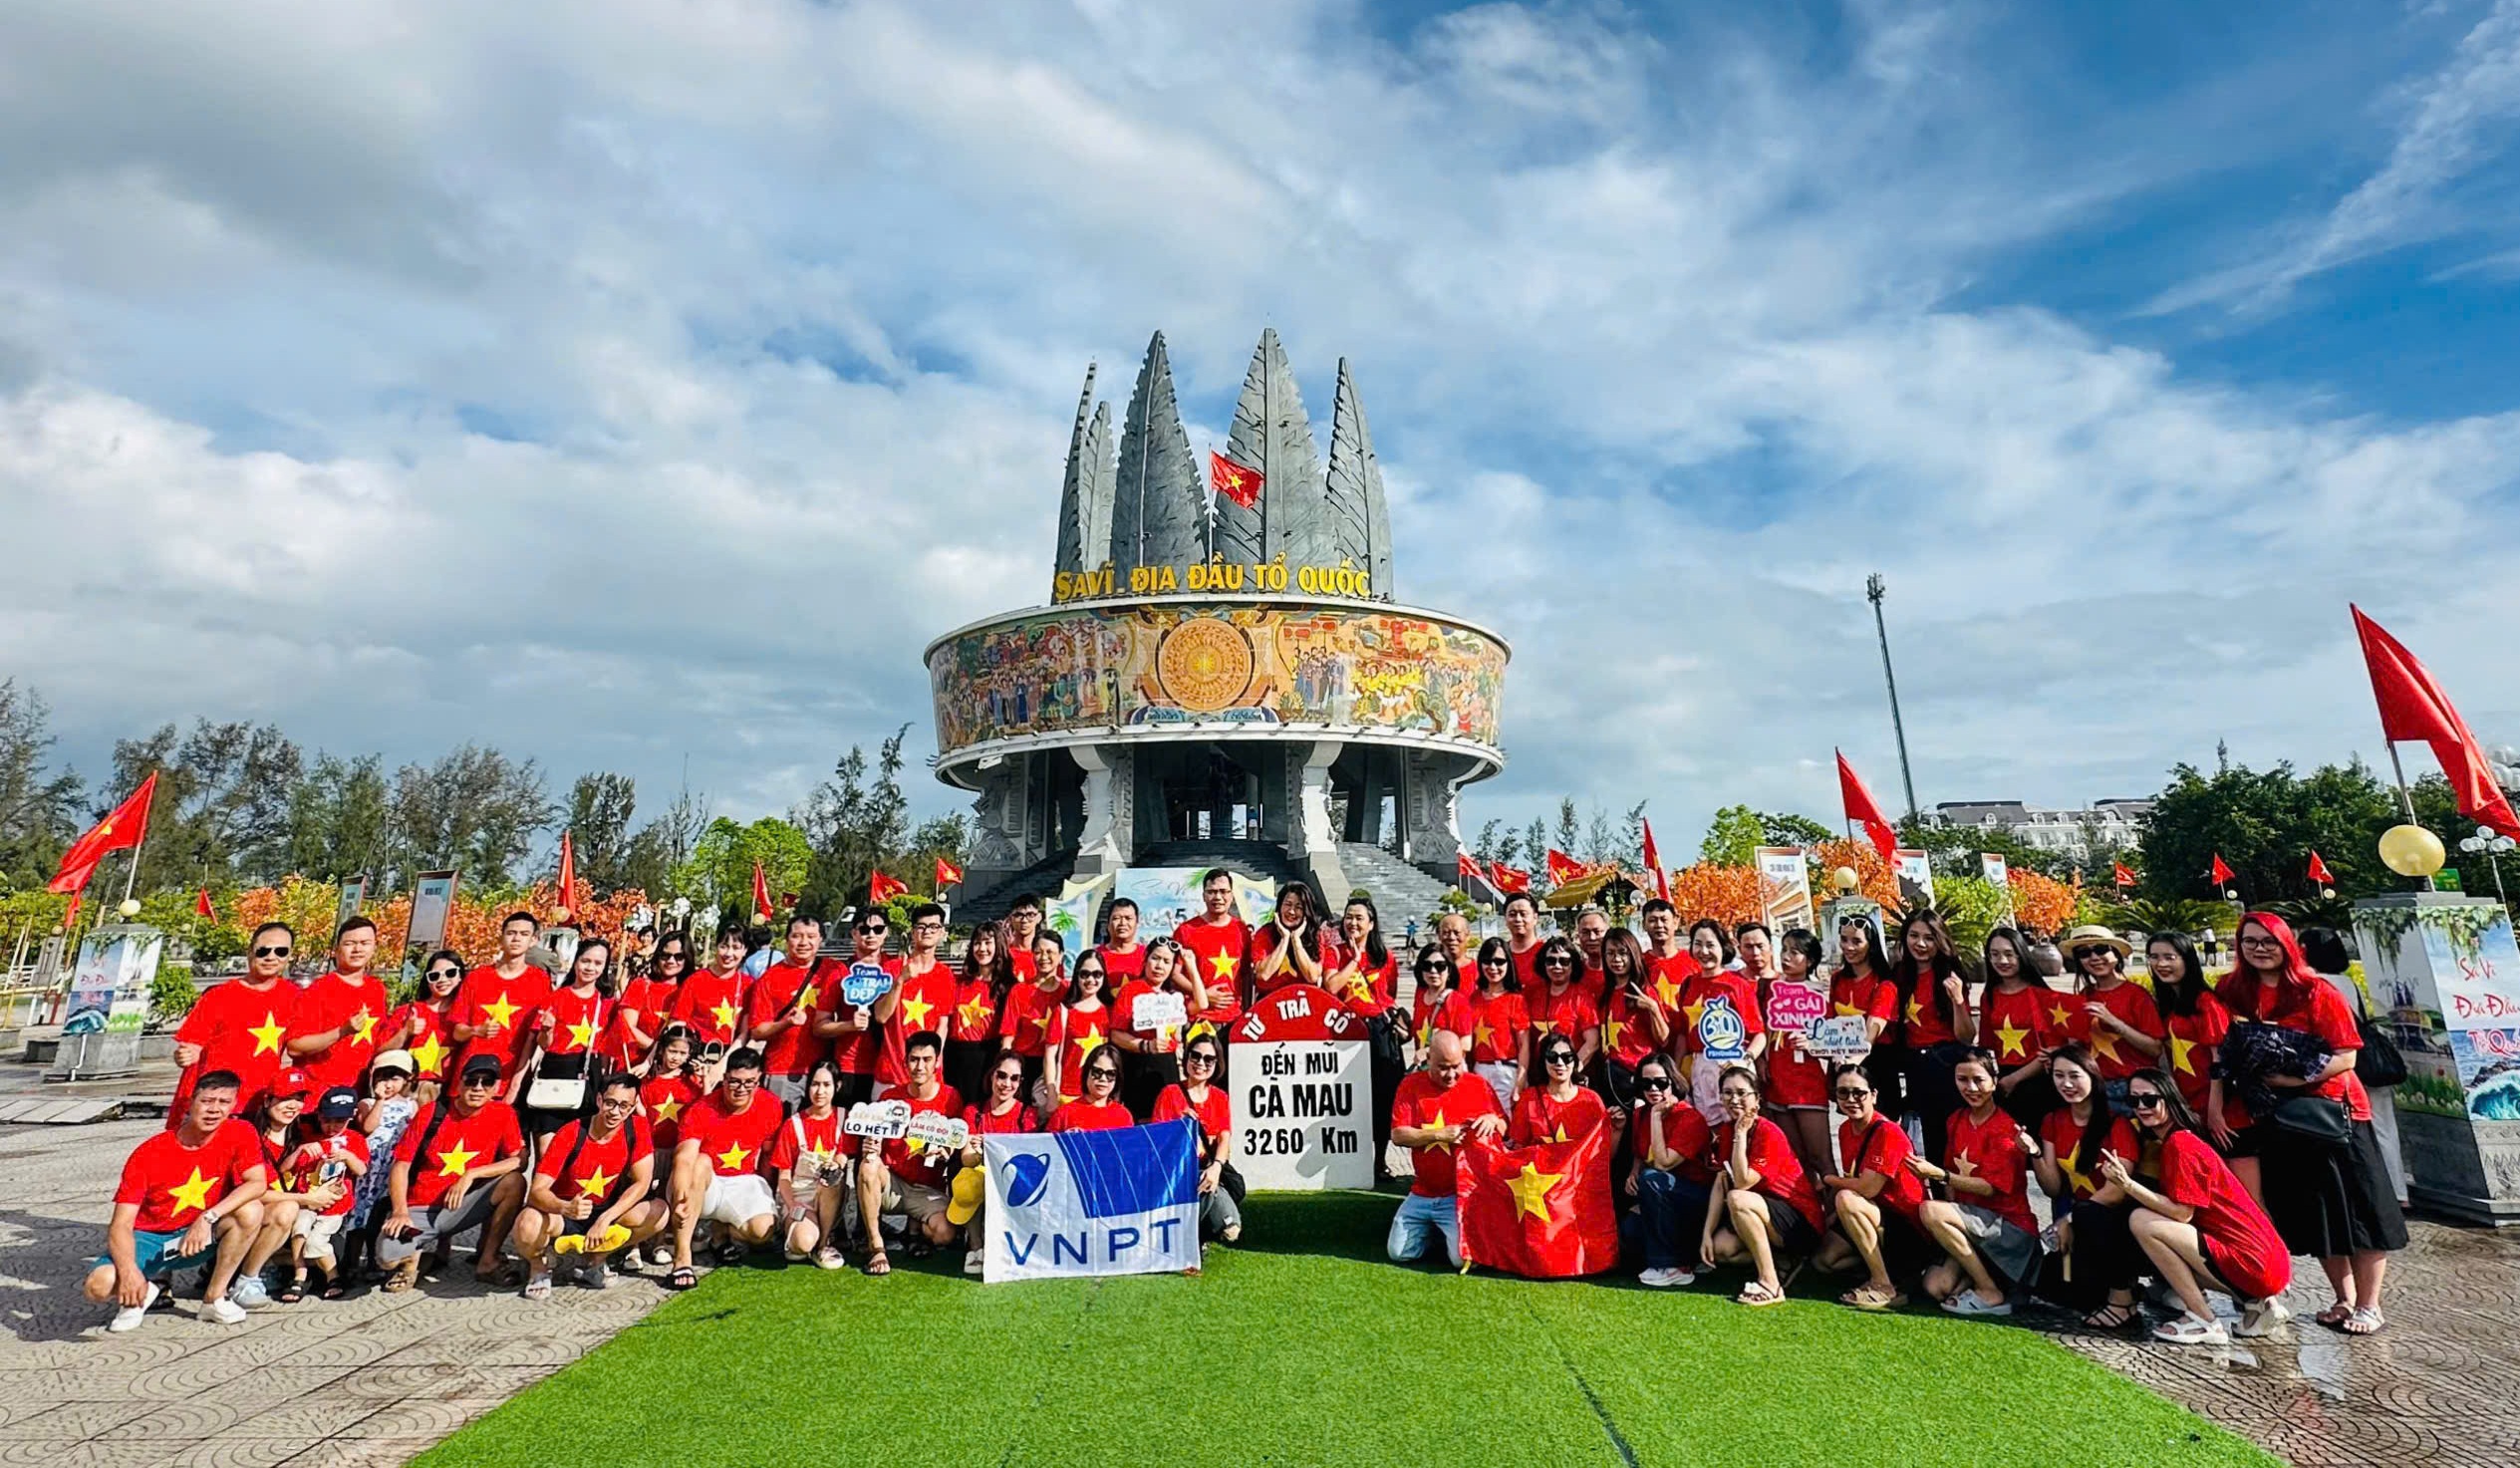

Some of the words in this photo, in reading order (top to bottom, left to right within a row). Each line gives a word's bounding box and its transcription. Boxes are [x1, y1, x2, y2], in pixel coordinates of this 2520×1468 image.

[1130, 564, 1177, 596] ĐỊA
[1187, 551, 1245, 591] ĐẦU
[1253, 551, 1288, 590] TỔ
[1297, 556, 1371, 597] QUỐC
[1777, 986, 1805, 996] Team
[1794, 995, 1820, 1011] GÁI
[1241, 1013, 1266, 1041] TỪ
[1276, 991, 1311, 1022] TRÀ
[1261, 1041, 1295, 1075] ĐẾN
[1305, 1041, 1339, 1075] MŨI
[1249, 1076, 1285, 1118] CÀ
[1291, 1082, 1353, 1118] MAU
[845, 1121, 862, 1133] LO
[865, 1121, 890, 1136] HẾT
[1244, 1127, 1304, 1156] 3260
[1321, 1126, 1359, 1154] Km
[1003, 1217, 1181, 1266] VNPT
